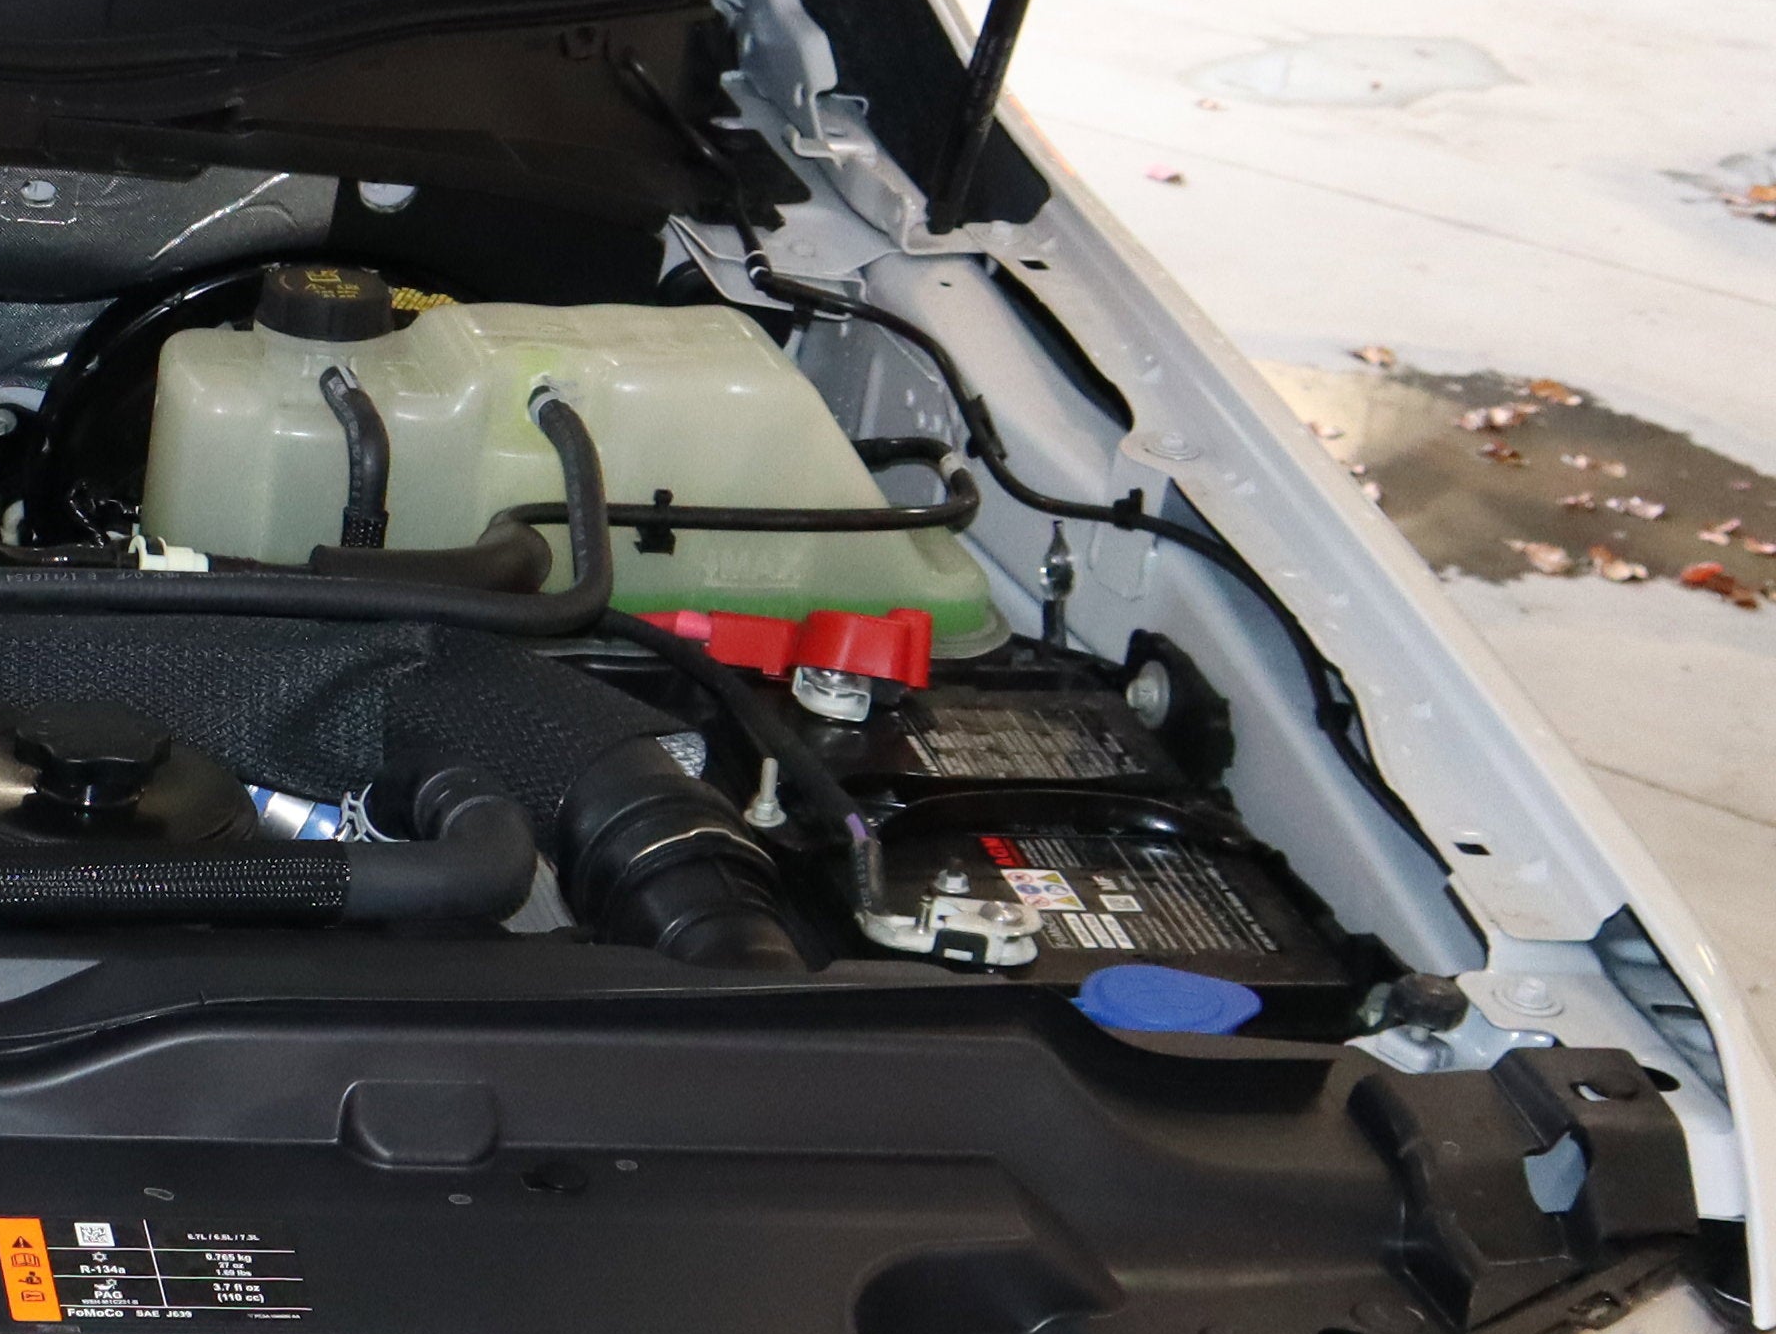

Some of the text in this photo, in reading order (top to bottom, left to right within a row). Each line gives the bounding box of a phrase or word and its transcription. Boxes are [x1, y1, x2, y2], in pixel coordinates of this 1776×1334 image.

[205, 1252, 253, 1264] 0.765 kg
[79, 1264, 126, 1275] R-134a
[218, 1261, 230, 1269] 27
[212, 1283, 260, 1292] 3.7 fl oz
[93, 1290, 123, 1299] PAG
[217, 1293, 265, 1304] (110 cc)
[67, 1308, 193, 1318] FoMoCo SAE J639
